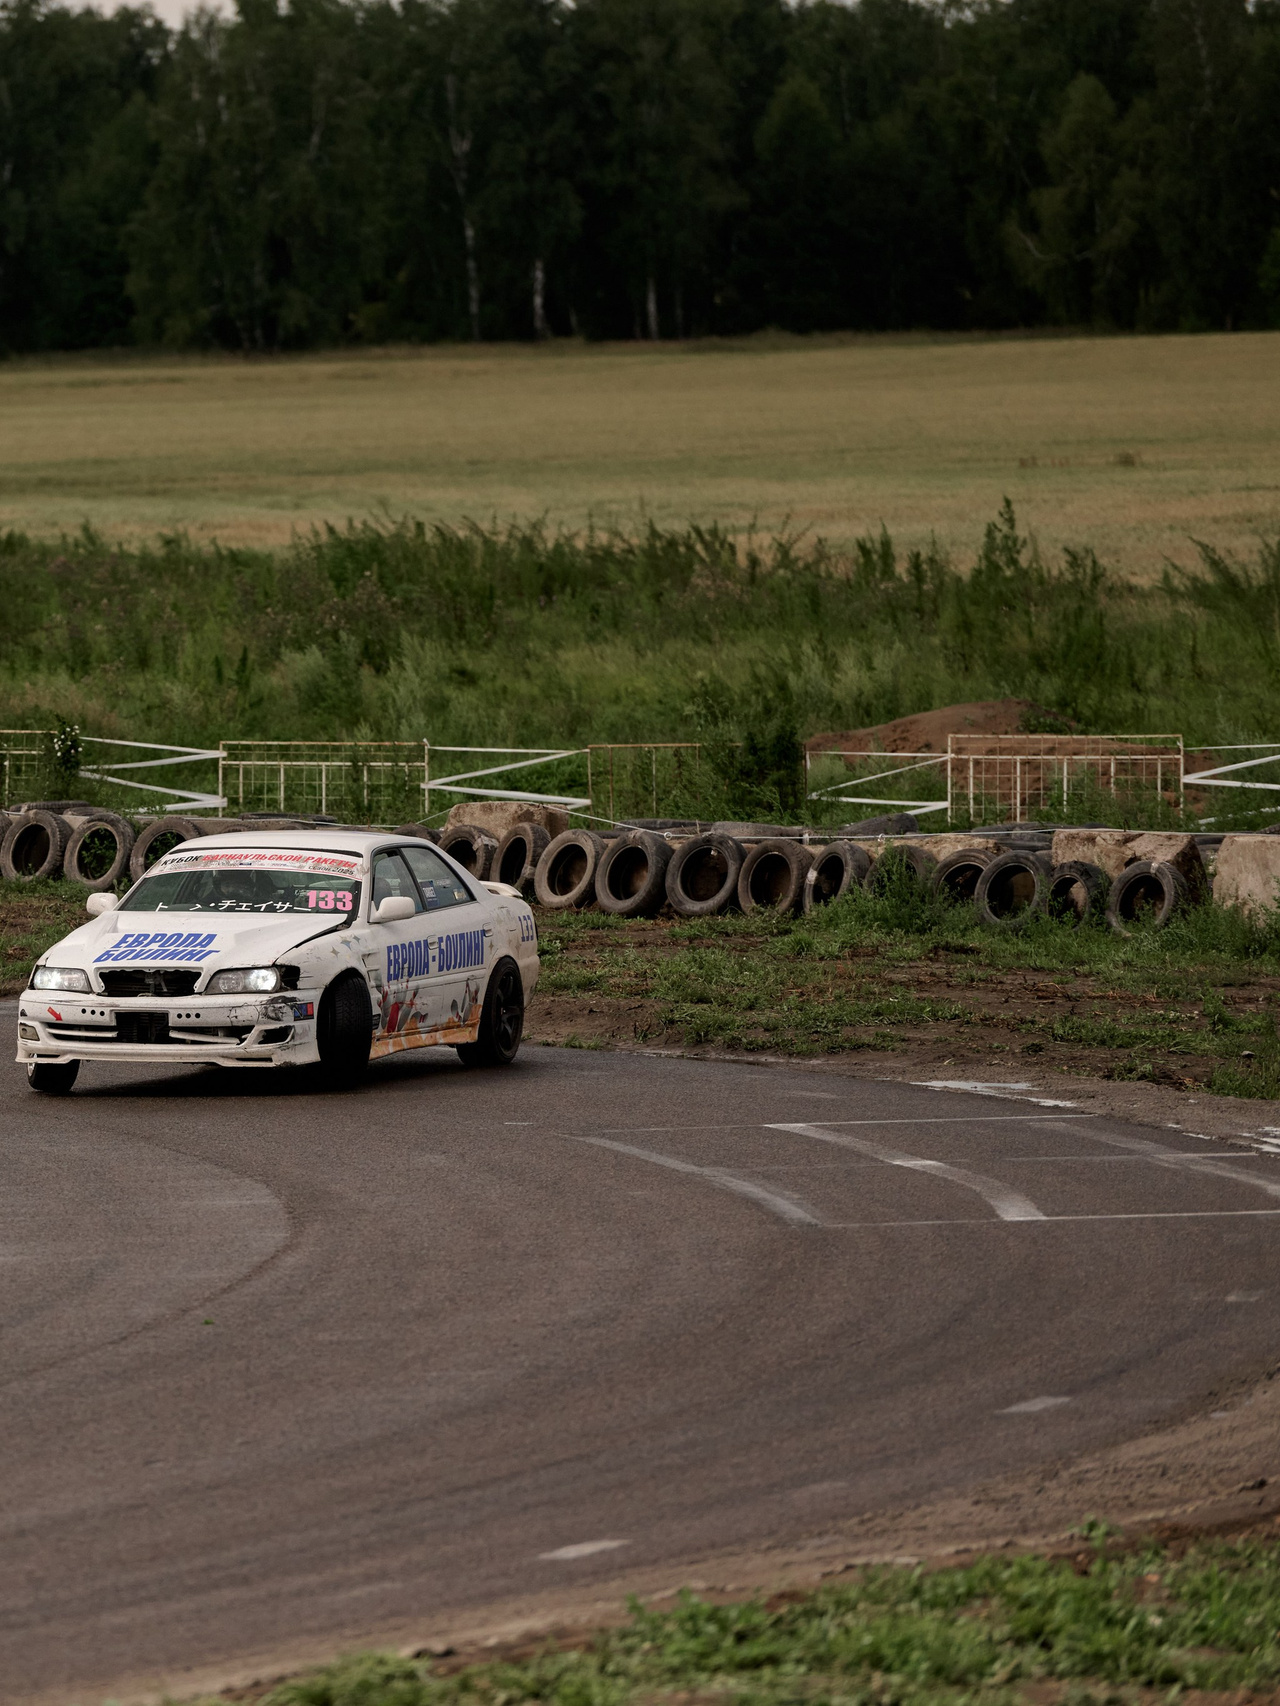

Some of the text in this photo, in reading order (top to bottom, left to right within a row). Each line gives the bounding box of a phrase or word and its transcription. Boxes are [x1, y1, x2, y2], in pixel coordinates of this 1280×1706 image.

[161, 855, 202, 867] КУБОК
[202, 853, 302, 862] БАРНАУЛЬСКОЙ
[303, 856, 357, 868] РАКЕТЫ
[332, 867, 355, 875] 2025
[307, 890, 353, 911] 133
[517, 914, 534, 942] 133
[110, 932, 218, 949] ЕВРОПА
[92, 948, 221, 963] БОУЛИНГ
[386, 938, 430, 982] ЕВРОПА
[437, 929, 486, 973] БОУЛИНГ
